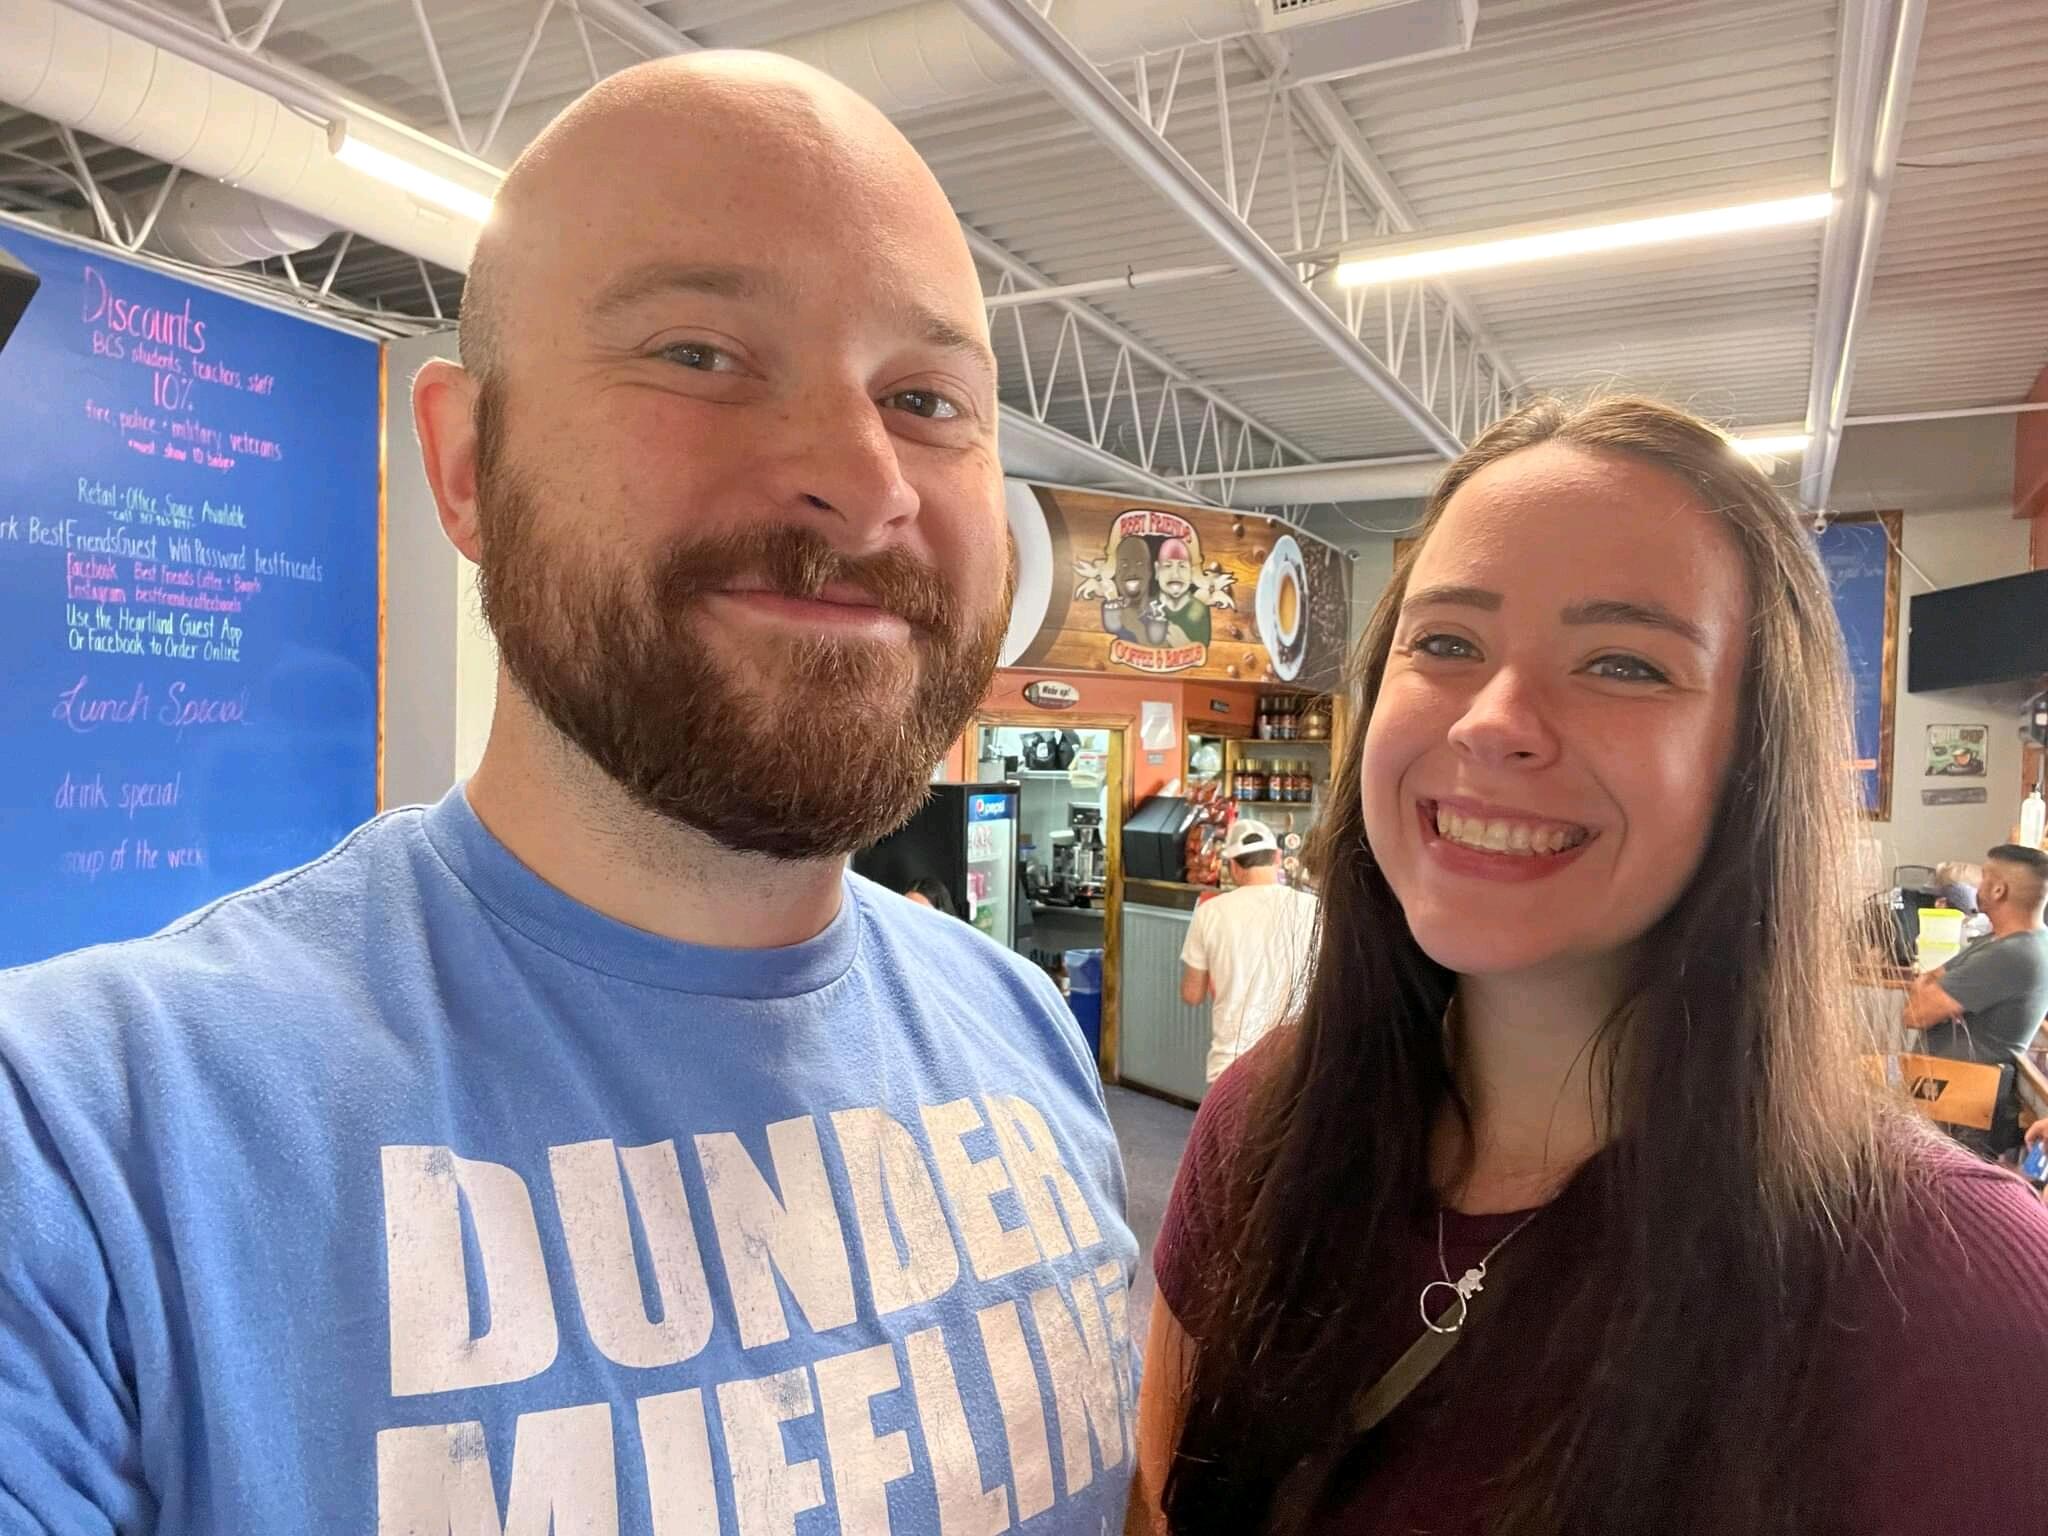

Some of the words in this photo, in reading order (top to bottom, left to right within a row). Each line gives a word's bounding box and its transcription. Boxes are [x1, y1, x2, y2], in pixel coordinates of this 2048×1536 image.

[93, 330, 126, 360] BCS
[151, 371, 195, 412] 10%
[67, 602, 90, 627] Use
[179, 613, 214, 639] Guest
[221, 617, 243, 648] App
[69, 628, 84, 650] Or
[87, 628, 145, 656] Facebook
[165, 636, 196, 659] Order
[52, 674, 150, 733] Lunch
[55, 771, 109, 809] drink
[118, 771, 181, 820] special
[134, 839, 159, 870] the
[379, 1094, 1103, 1398] DUNDER
